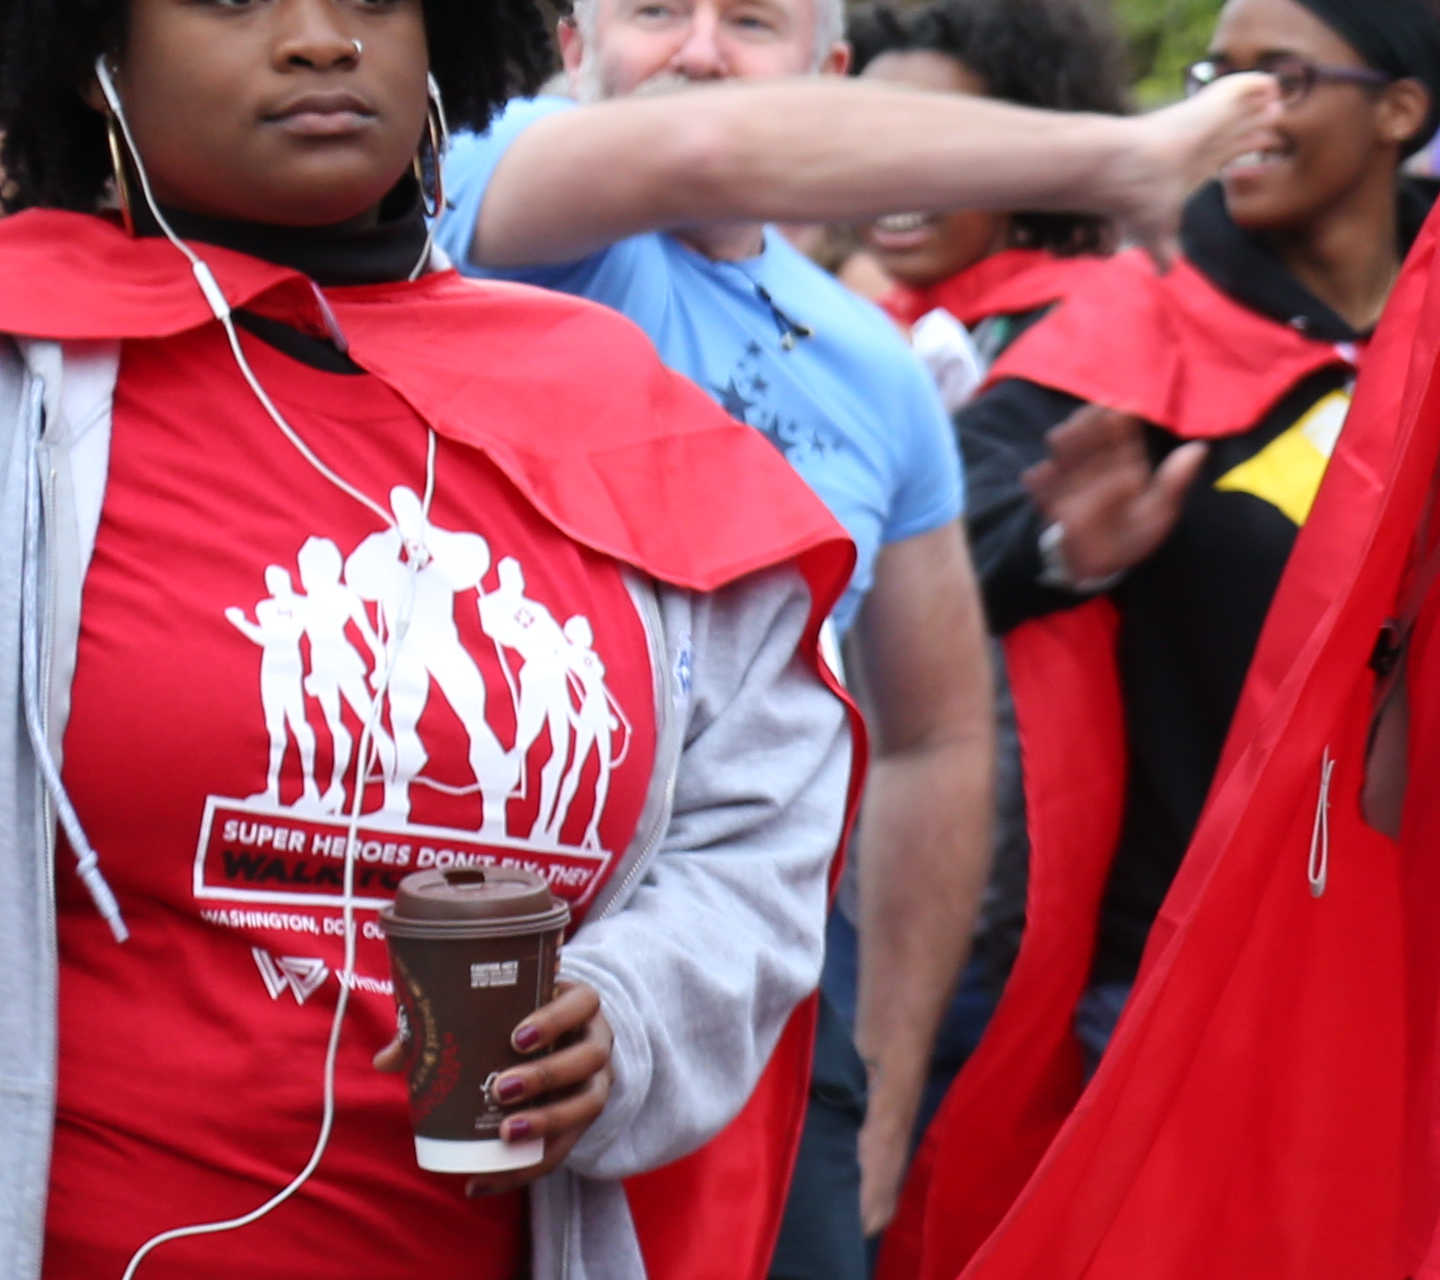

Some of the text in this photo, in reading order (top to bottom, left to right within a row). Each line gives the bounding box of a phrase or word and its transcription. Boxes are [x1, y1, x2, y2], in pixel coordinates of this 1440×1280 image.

[223, 820, 305, 852] SUPER
[312, 834, 411, 866] HEROES
[547, 865, 592, 886] THEY
[223, 850, 345, 888] WALK
